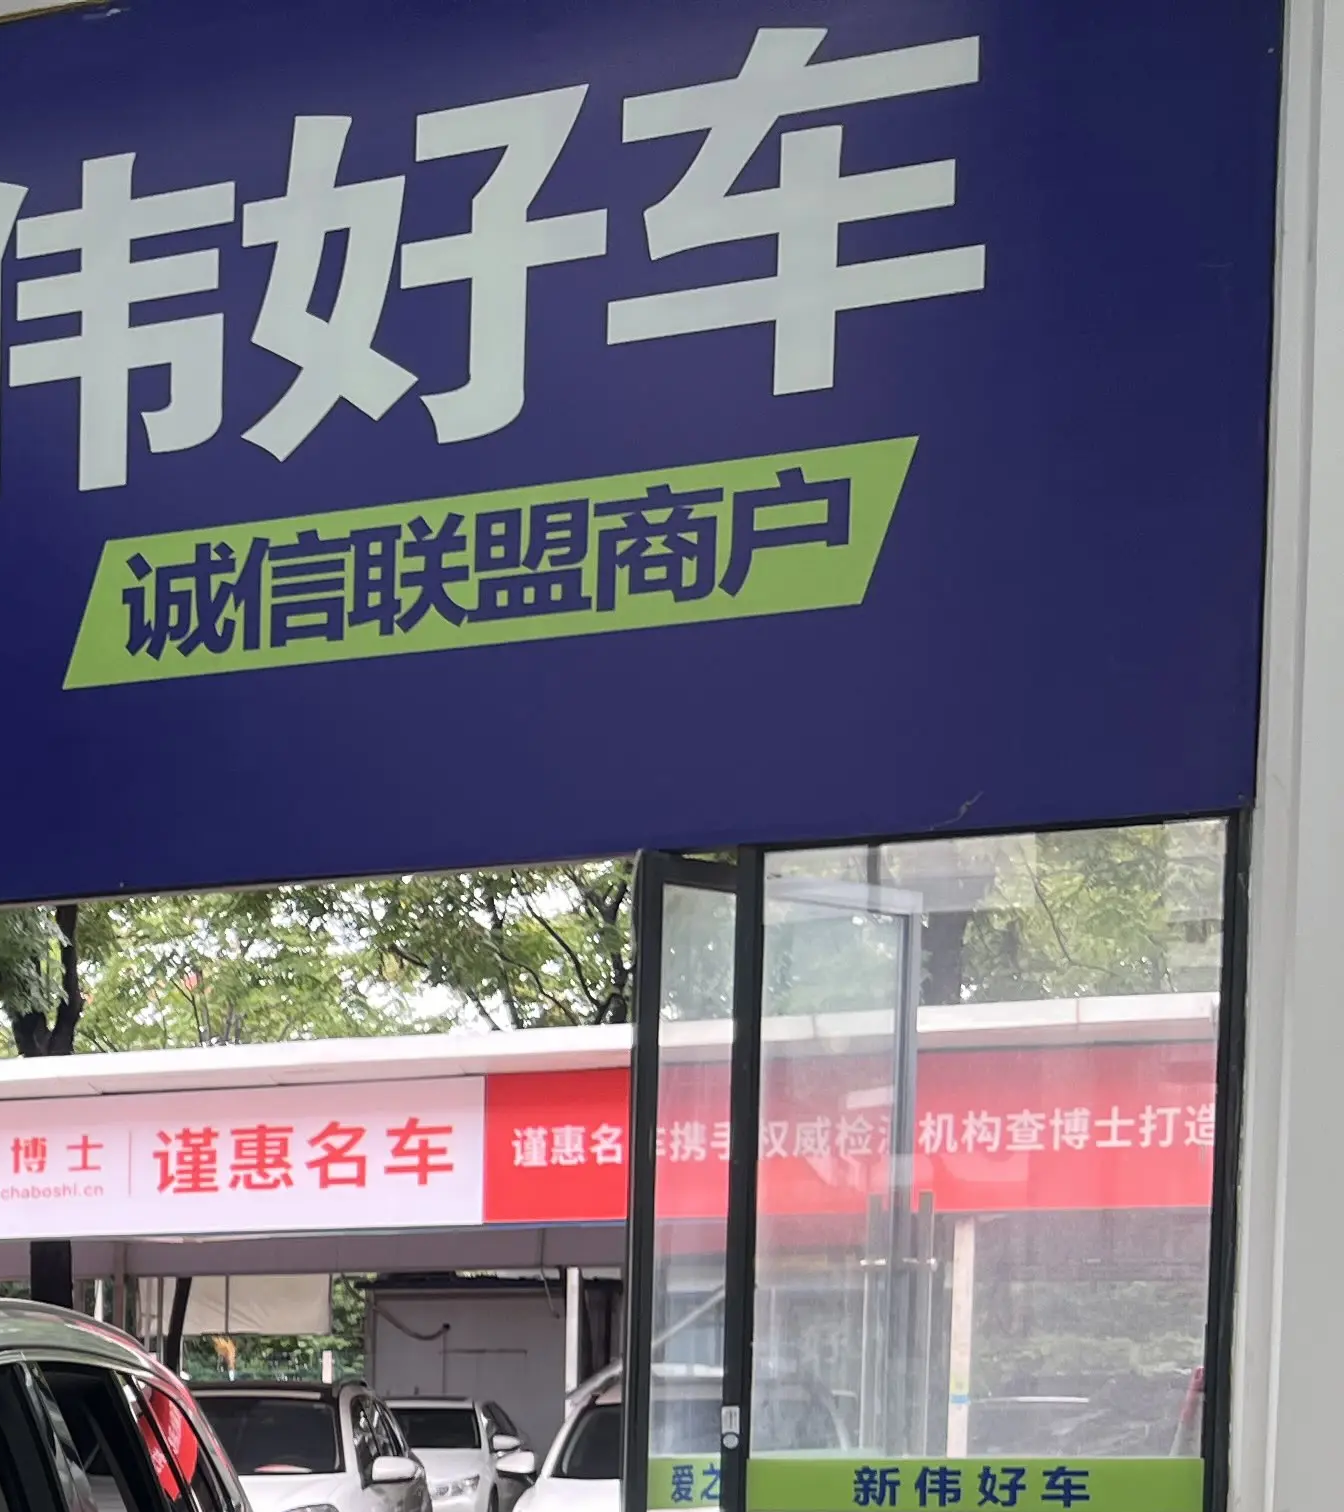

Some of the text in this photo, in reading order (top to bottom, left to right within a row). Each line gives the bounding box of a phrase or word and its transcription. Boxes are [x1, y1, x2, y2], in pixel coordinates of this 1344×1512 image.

[118, 466, 853, 663] 诚信联盟商户
[153, 1116, 455, 1194] 谨惠名车
[852, 1465, 1091, 1508] 新伟好车
